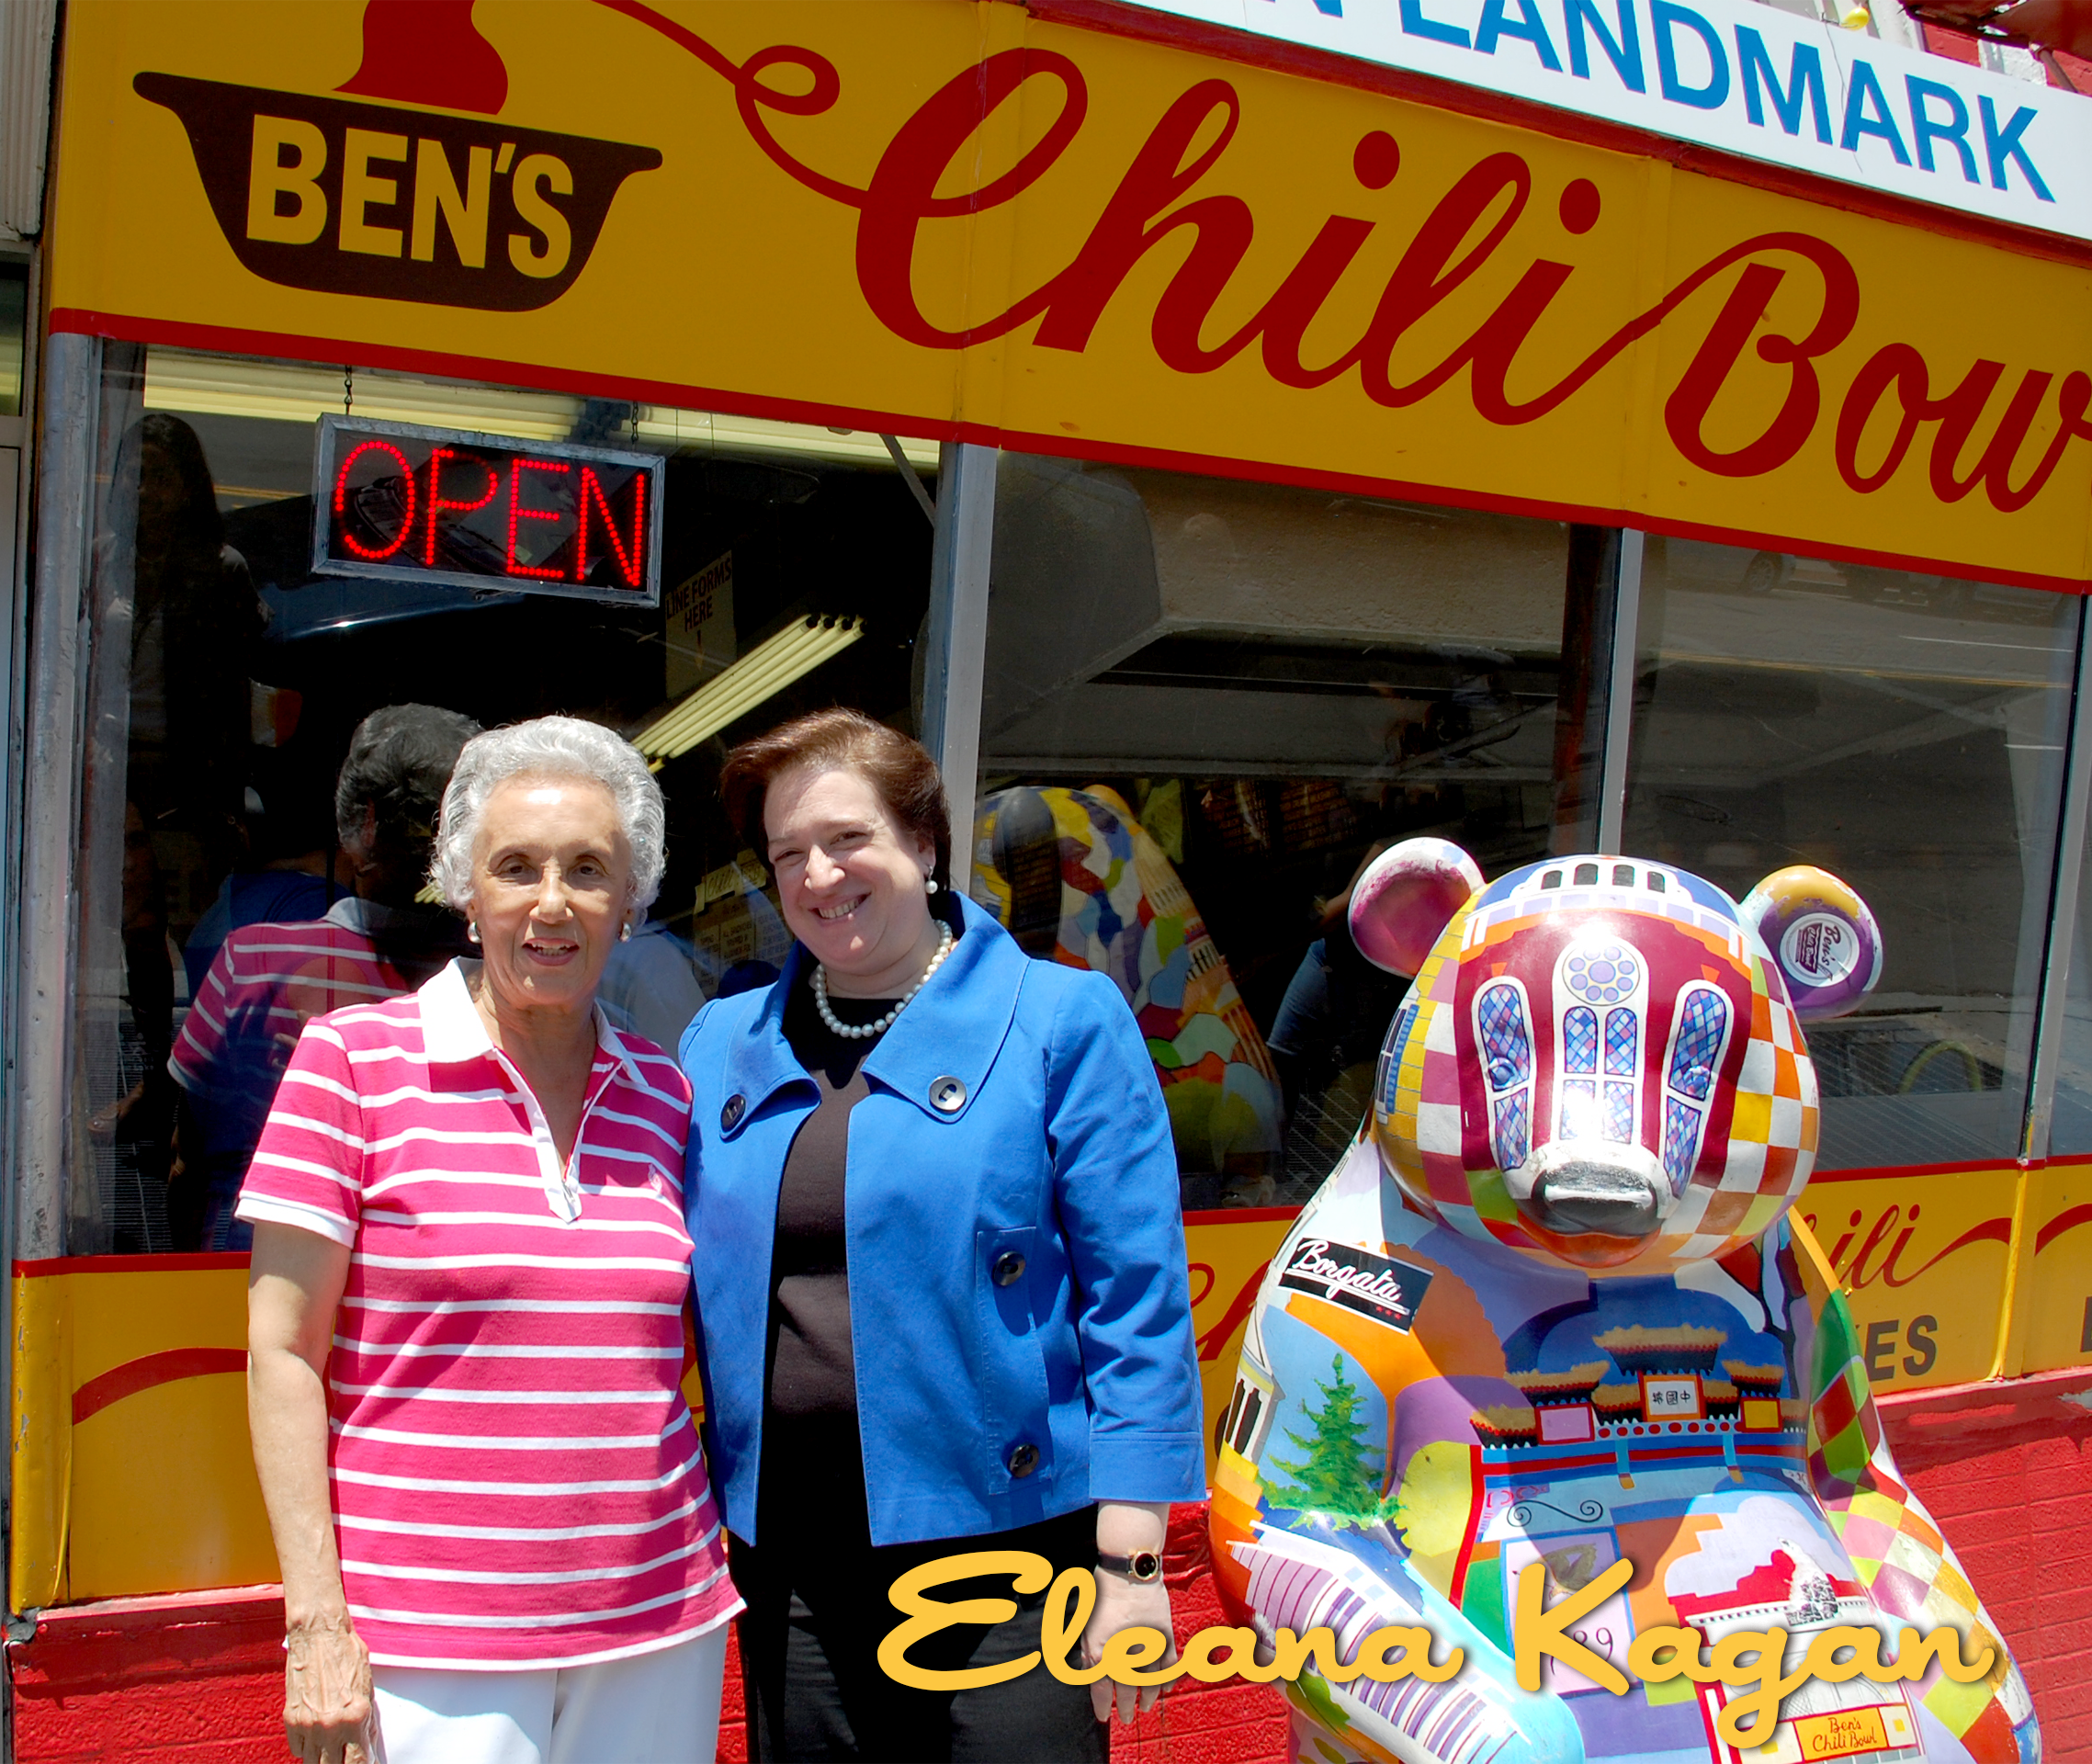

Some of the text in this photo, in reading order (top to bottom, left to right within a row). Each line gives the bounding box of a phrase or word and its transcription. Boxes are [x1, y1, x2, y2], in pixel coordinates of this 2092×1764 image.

[246, 115, 574, 279] BEN'S
[855, 48, 2092, 513] Chili Bow
[334, 440, 646, 587] OPEN
[666, 557, 732, 620] LINE FORMS
[684, 595, 713, 633] HERE
[1821, 924, 1842, 967] Ben's
[1291, 1240, 1401, 1300] Borgata
[1812, 1725, 1878, 1753] Chili Bowl
[1827, 1716, 1862, 1734] Ben's
